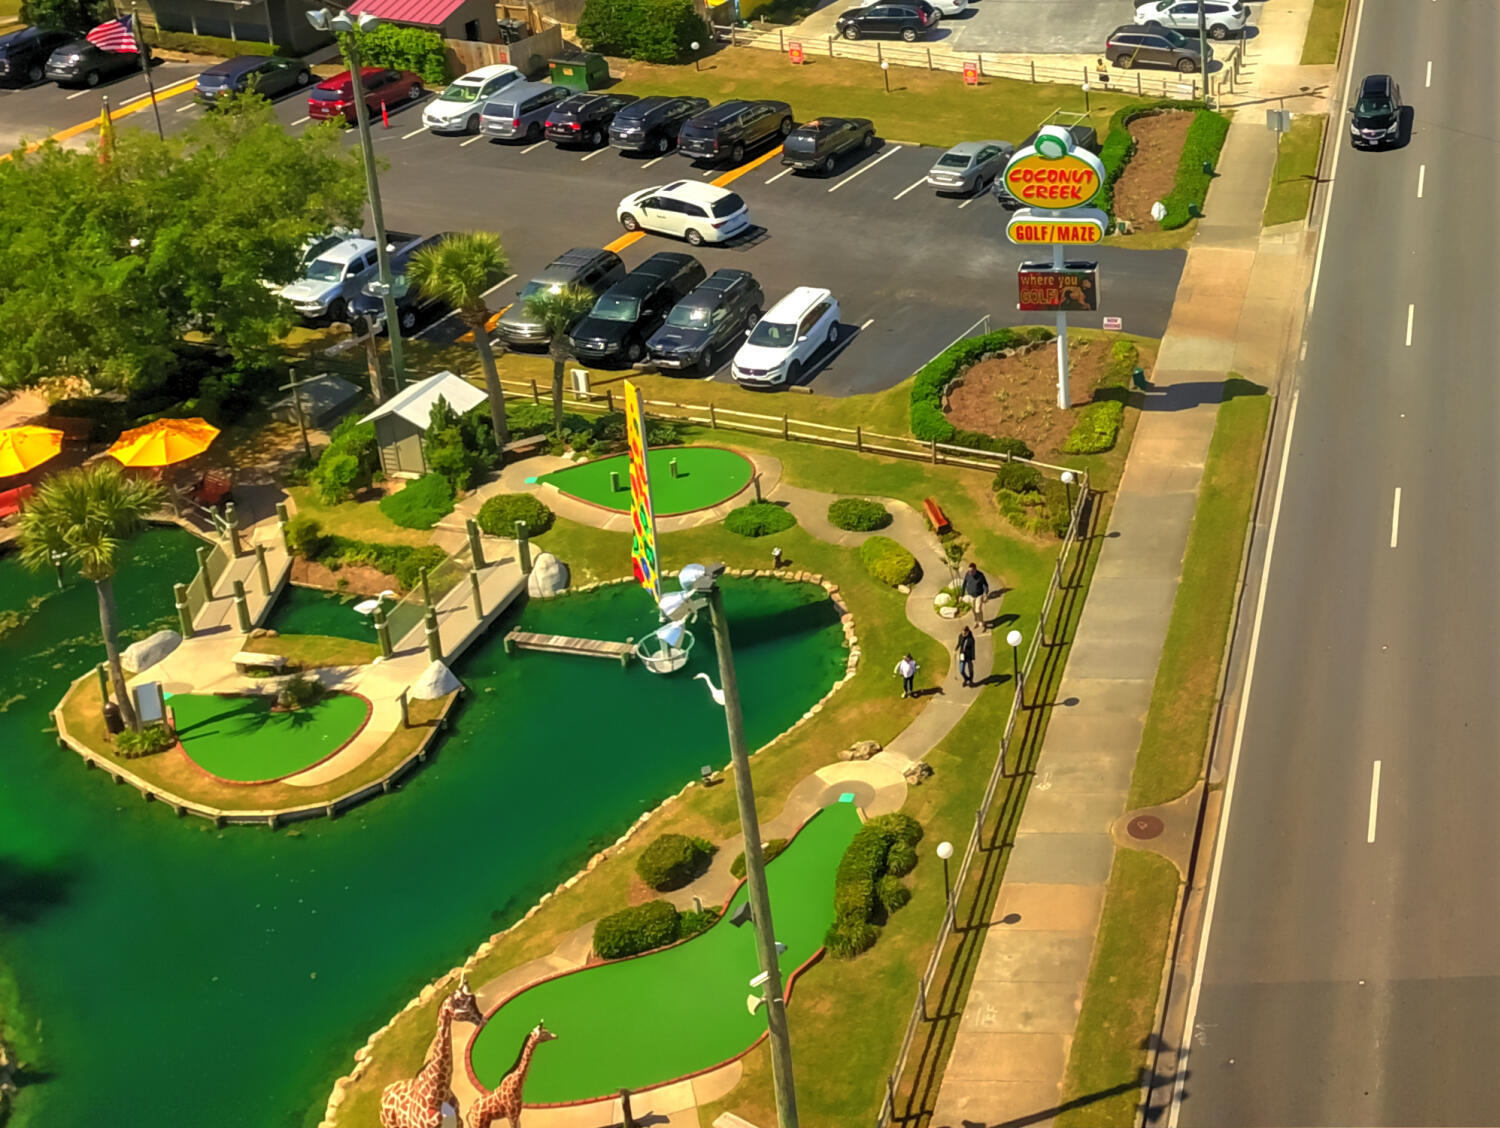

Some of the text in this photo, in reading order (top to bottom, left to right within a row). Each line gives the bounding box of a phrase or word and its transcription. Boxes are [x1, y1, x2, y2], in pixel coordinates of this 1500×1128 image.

[1009, 169, 1093, 184] COCONUT
[1022, 185, 1082, 200] CREEK
[1021, 274, 1078, 288] where you
